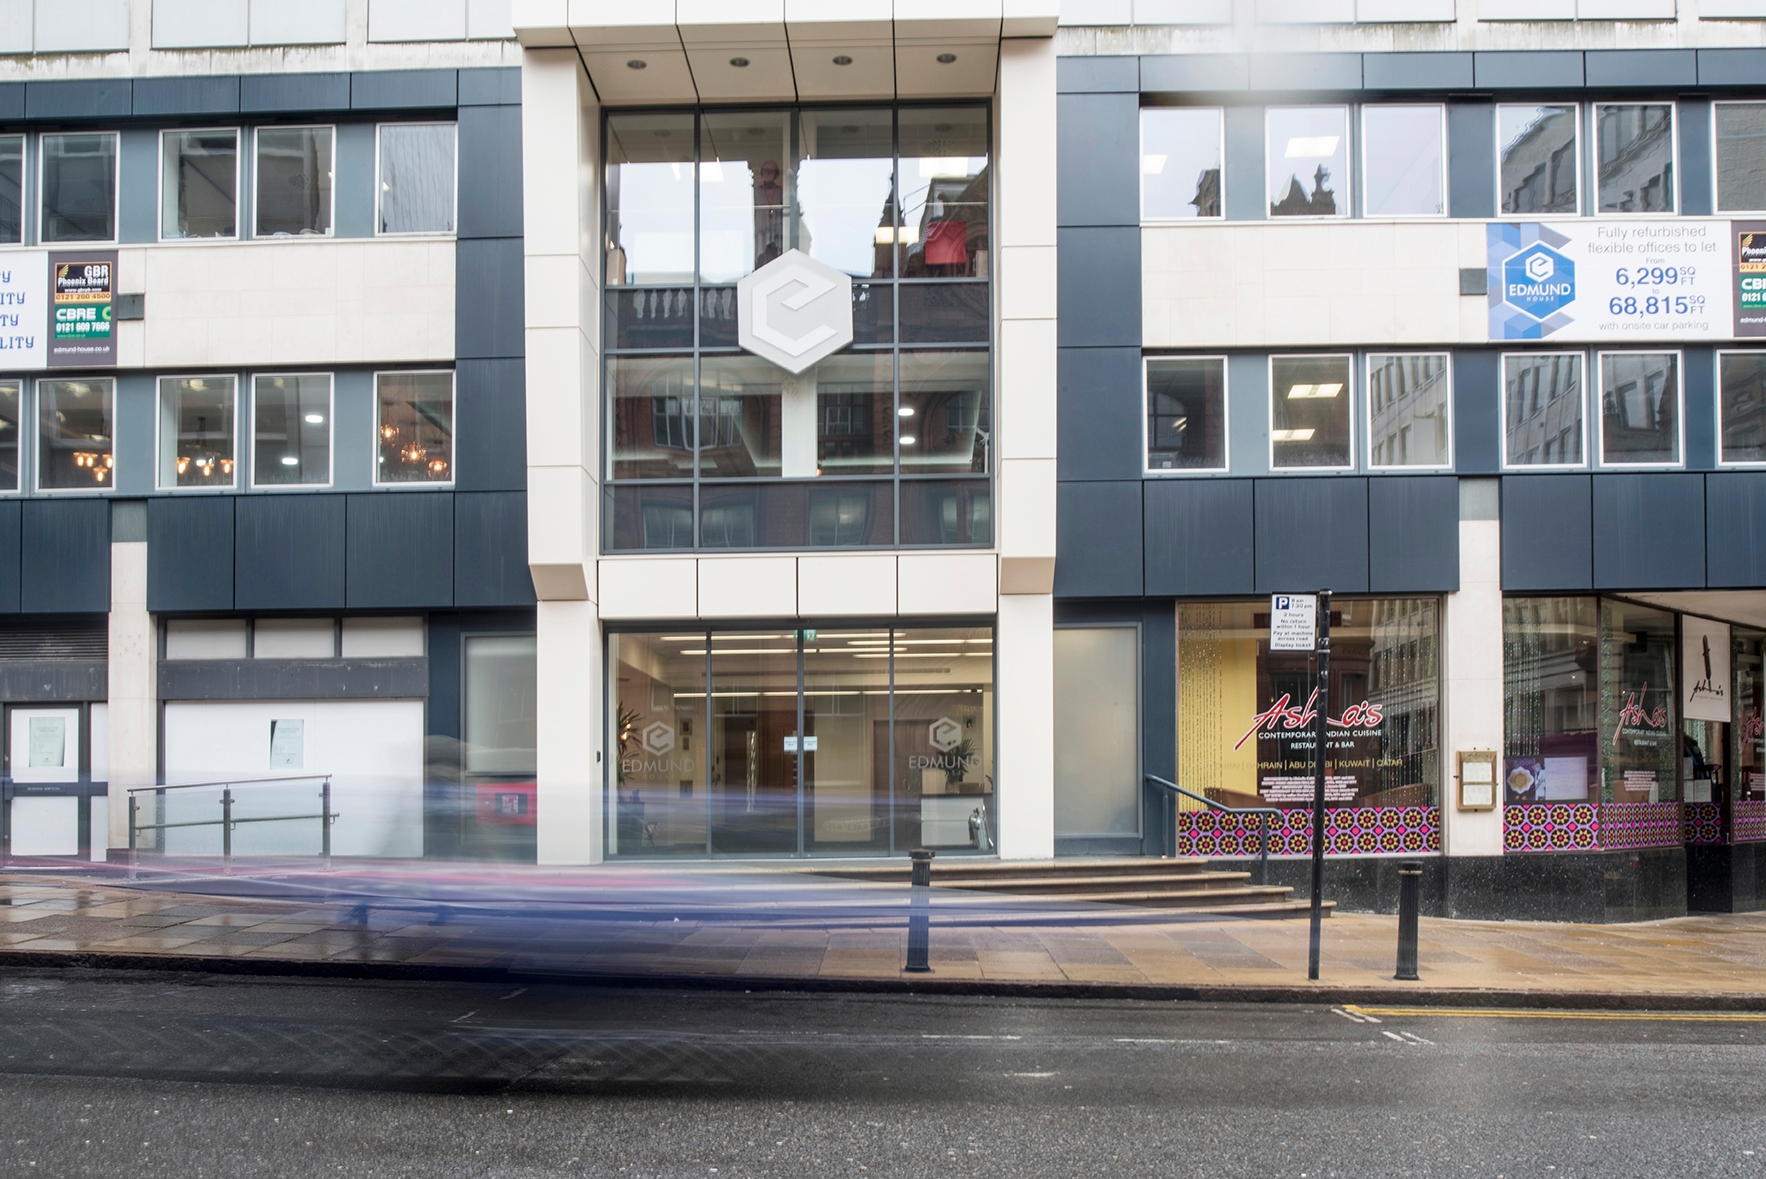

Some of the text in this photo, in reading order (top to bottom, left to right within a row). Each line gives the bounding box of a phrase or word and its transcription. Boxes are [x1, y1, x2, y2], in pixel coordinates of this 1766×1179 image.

[1597, 226, 1706, 240] Fully refurbished
[1588, 241, 1716, 253] flexible offices to let
[1, 271, 11, 283] Y
[84, 265, 108, 278] GBR
[1616, 266, 1696, 289] 6,299 SQ
[58, 277, 86, 286] Phoenix
[1681, 277, 1695, 285] FT
[1509, 283, 1570, 296] EDMUND
[1742, 292, 1760, 302] 0121
[1609, 295, 1705, 318] 68,815 SQ
[1691, 305, 1705, 314] FT
[56, 308, 96, 321] CBRE
[56, 322, 74, 333] 0121
[76, 322, 90, 333] 609
[1599, 322, 1619, 330] with
[1622, 321, 1651, 330] onsite
[1672, 321, 1708, 331] parking
[1612, 681, 1667, 746] Asha's
[1258, 729, 1382, 739] CONTEMPORAR NDIAN CUISINE
[622, 759, 695, 772] EDMUND
[908, 756, 982, 769] EDMUND
[1308, 760, 1332, 768] DBI
[1339, 759, 1370, 767] KUWAIT
[1376, 758, 1403, 766] QATAR
